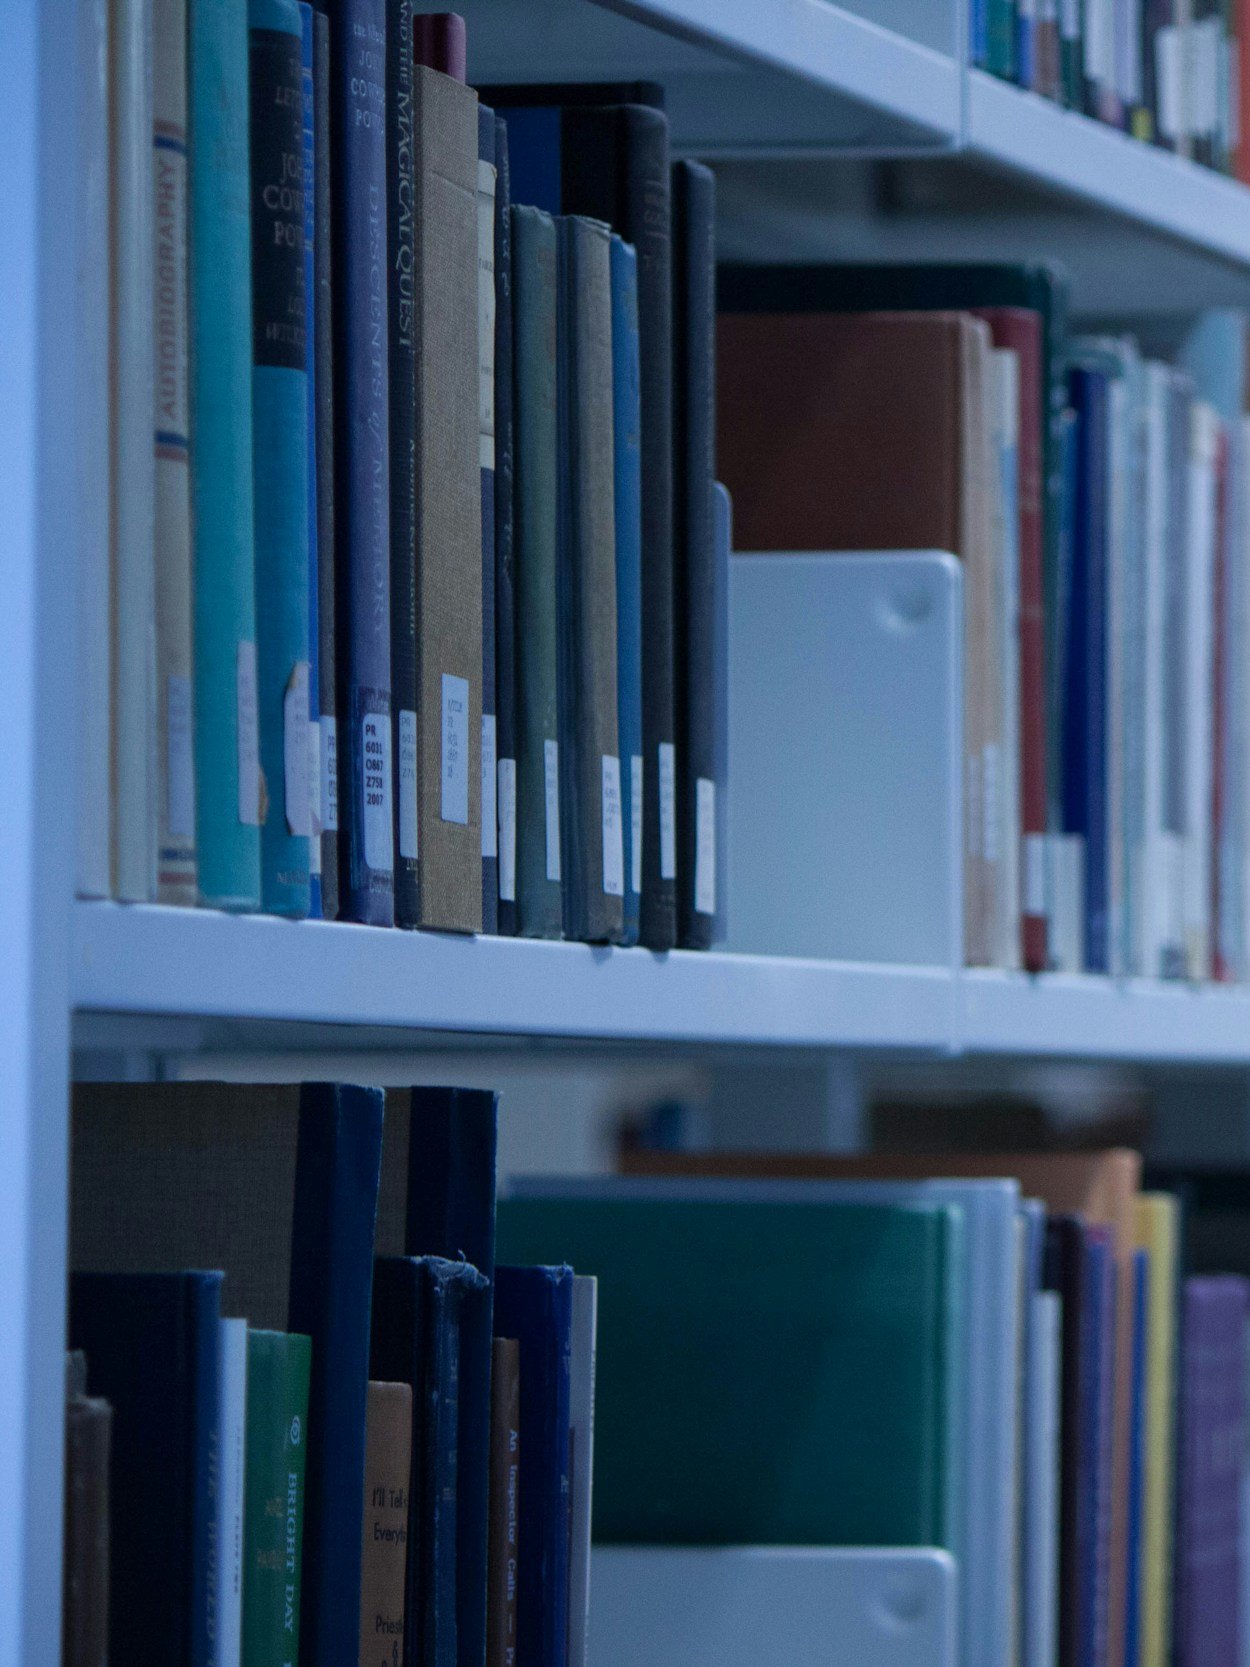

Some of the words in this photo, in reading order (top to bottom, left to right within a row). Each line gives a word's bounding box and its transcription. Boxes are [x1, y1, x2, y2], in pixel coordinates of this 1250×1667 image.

[397, 91, 412, 239] MAGICAL
[157, 159, 176, 419] AUTOBIOGRAPHY
[369, 184, 383, 398] DESCENTS
[396, 243, 412, 349] QUEST
[365, 724, 376, 736] PR
[365, 741, 383, 755] 6031
[366, 792, 384, 805] 2007
[508, 1429, 519, 1451] An
[286, 1472, 298, 1573] BRIGHT
[507, 1464, 518, 1544] Inspector
[284, 1584, 294, 1632] DAY
[506, 1558, 517, 1601] Calls
